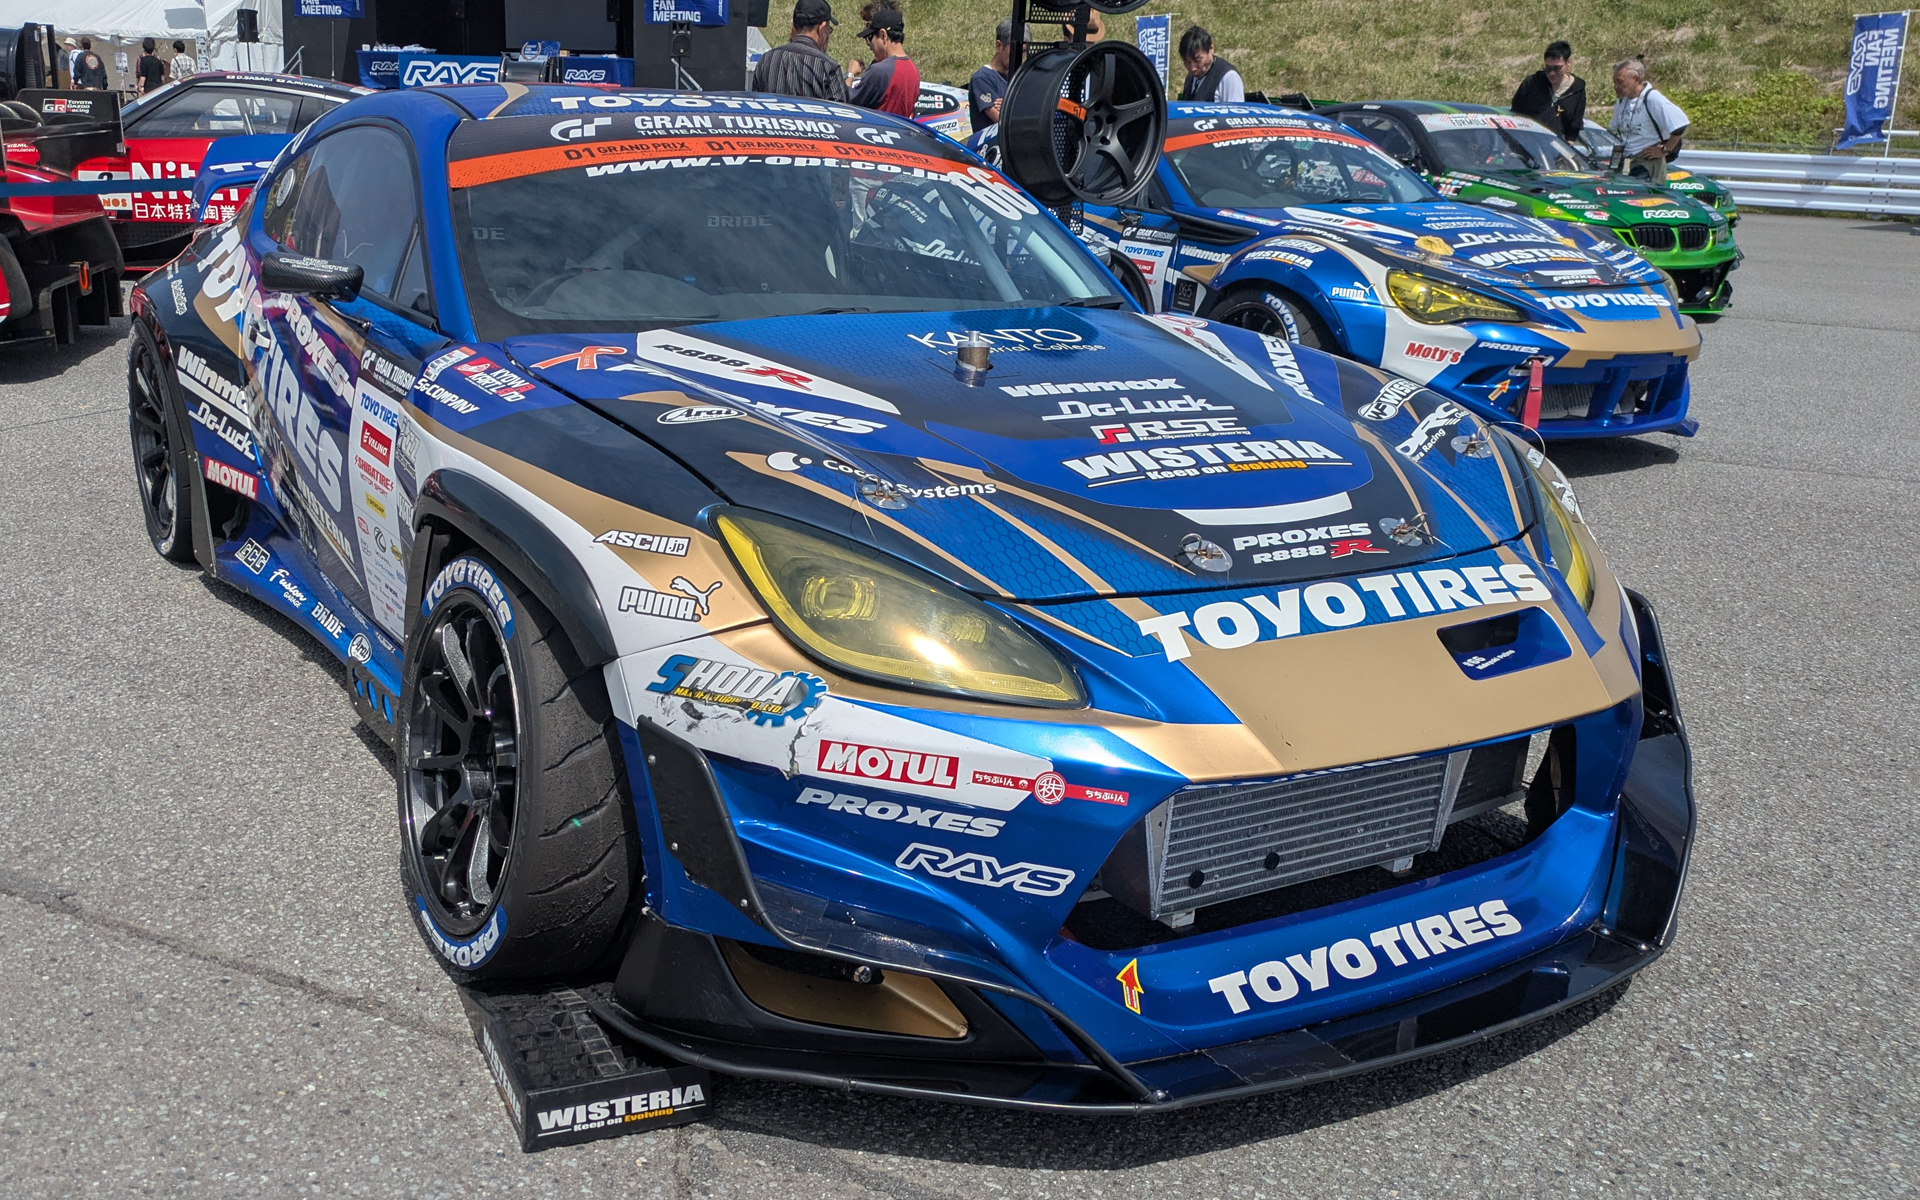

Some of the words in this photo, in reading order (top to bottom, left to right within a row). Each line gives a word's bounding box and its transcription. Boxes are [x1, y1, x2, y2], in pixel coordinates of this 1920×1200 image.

[301, 5, 342, 15] MEETING
[653, 0, 675, 10] FAN
[653, 11, 701, 22] MEETING
[403, 60, 500, 86] RAYS
[564, 69, 606, 80] RAYS
[44, 103, 66, 112] GR
[634, 115, 713, 130] GRAN
[716, 115, 836, 134] TURISMO
[1225, 117, 1260, 126] GRAN
[708, 128, 765, 137] DRIVING
[766, 130, 840, 140] SIMULATOR
[564, 146, 596, 160] D1
[597, 143, 650, 154] GRAND
[652, 140, 691, 150] PRIX
[706, 140, 736, 152] D1
[736, 140, 787, 150] GRAND
[788, 141, 820, 151] PRIX
[833, 145, 861, 157] D1
[860, 148, 902, 160] GRAND
[905, 154, 934, 165] PRIX
[706, 215, 773, 228] BRIDE
[1180, 244, 1232, 263] Winmax
[1331, 286, 1366, 299] PUMA
[1032, 342, 1107, 352] College
[1404, 341, 1462, 365] Moty's
[1479, 341, 1541, 354] PROXES
[375, 357, 393, 380] GRAN
[391, 365, 416, 389] TURISM
[413, 377, 480, 415] S&COMPANY
[999, 377, 1187, 398] Winmax
[1128, 416, 1249, 437] RSE
[1163, 433, 1195, 441] Speed
[1194, 429, 1252, 438] Engineering
[368, 434, 388, 457] VALINO
[1421, 427, 1447, 454] Racing
[1060, 439, 1344, 480] WISTERIA
[1146, 468, 1201, 480] Keep
[1204, 465, 1229, 474] on
[1226, 459, 1308, 474] Evolving
[206, 459, 257, 499] MOTUL
[594, 529, 691, 557] ASCII.jp
[1233, 522, 1372, 551] PROXES
[269, 568, 307, 601] Fusion
[619, 586, 698, 621] PUMA
[311, 601, 346, 640] BRIDE
[646, 654, 799, 705] SHODA
[820, 742, 955, 787] MOTUL
[974, 773, 1015, 787] ちちぶりん
[1038, 777, 1062, 802] 秩
[1085, 789, 1126, 803] ちちぶりん
[795, 787, 1007, 838] PROXES
[895, 842, 1076, 897] RAYS
[421, 910, 500, 967] PROXES
[537, 1083, 705, 1131] WISTERIA
[574, 1119, 606, 1132] Keep
[607, 1116, 623, 1126] on
[624, 1107, 674, 1123] Evolving
